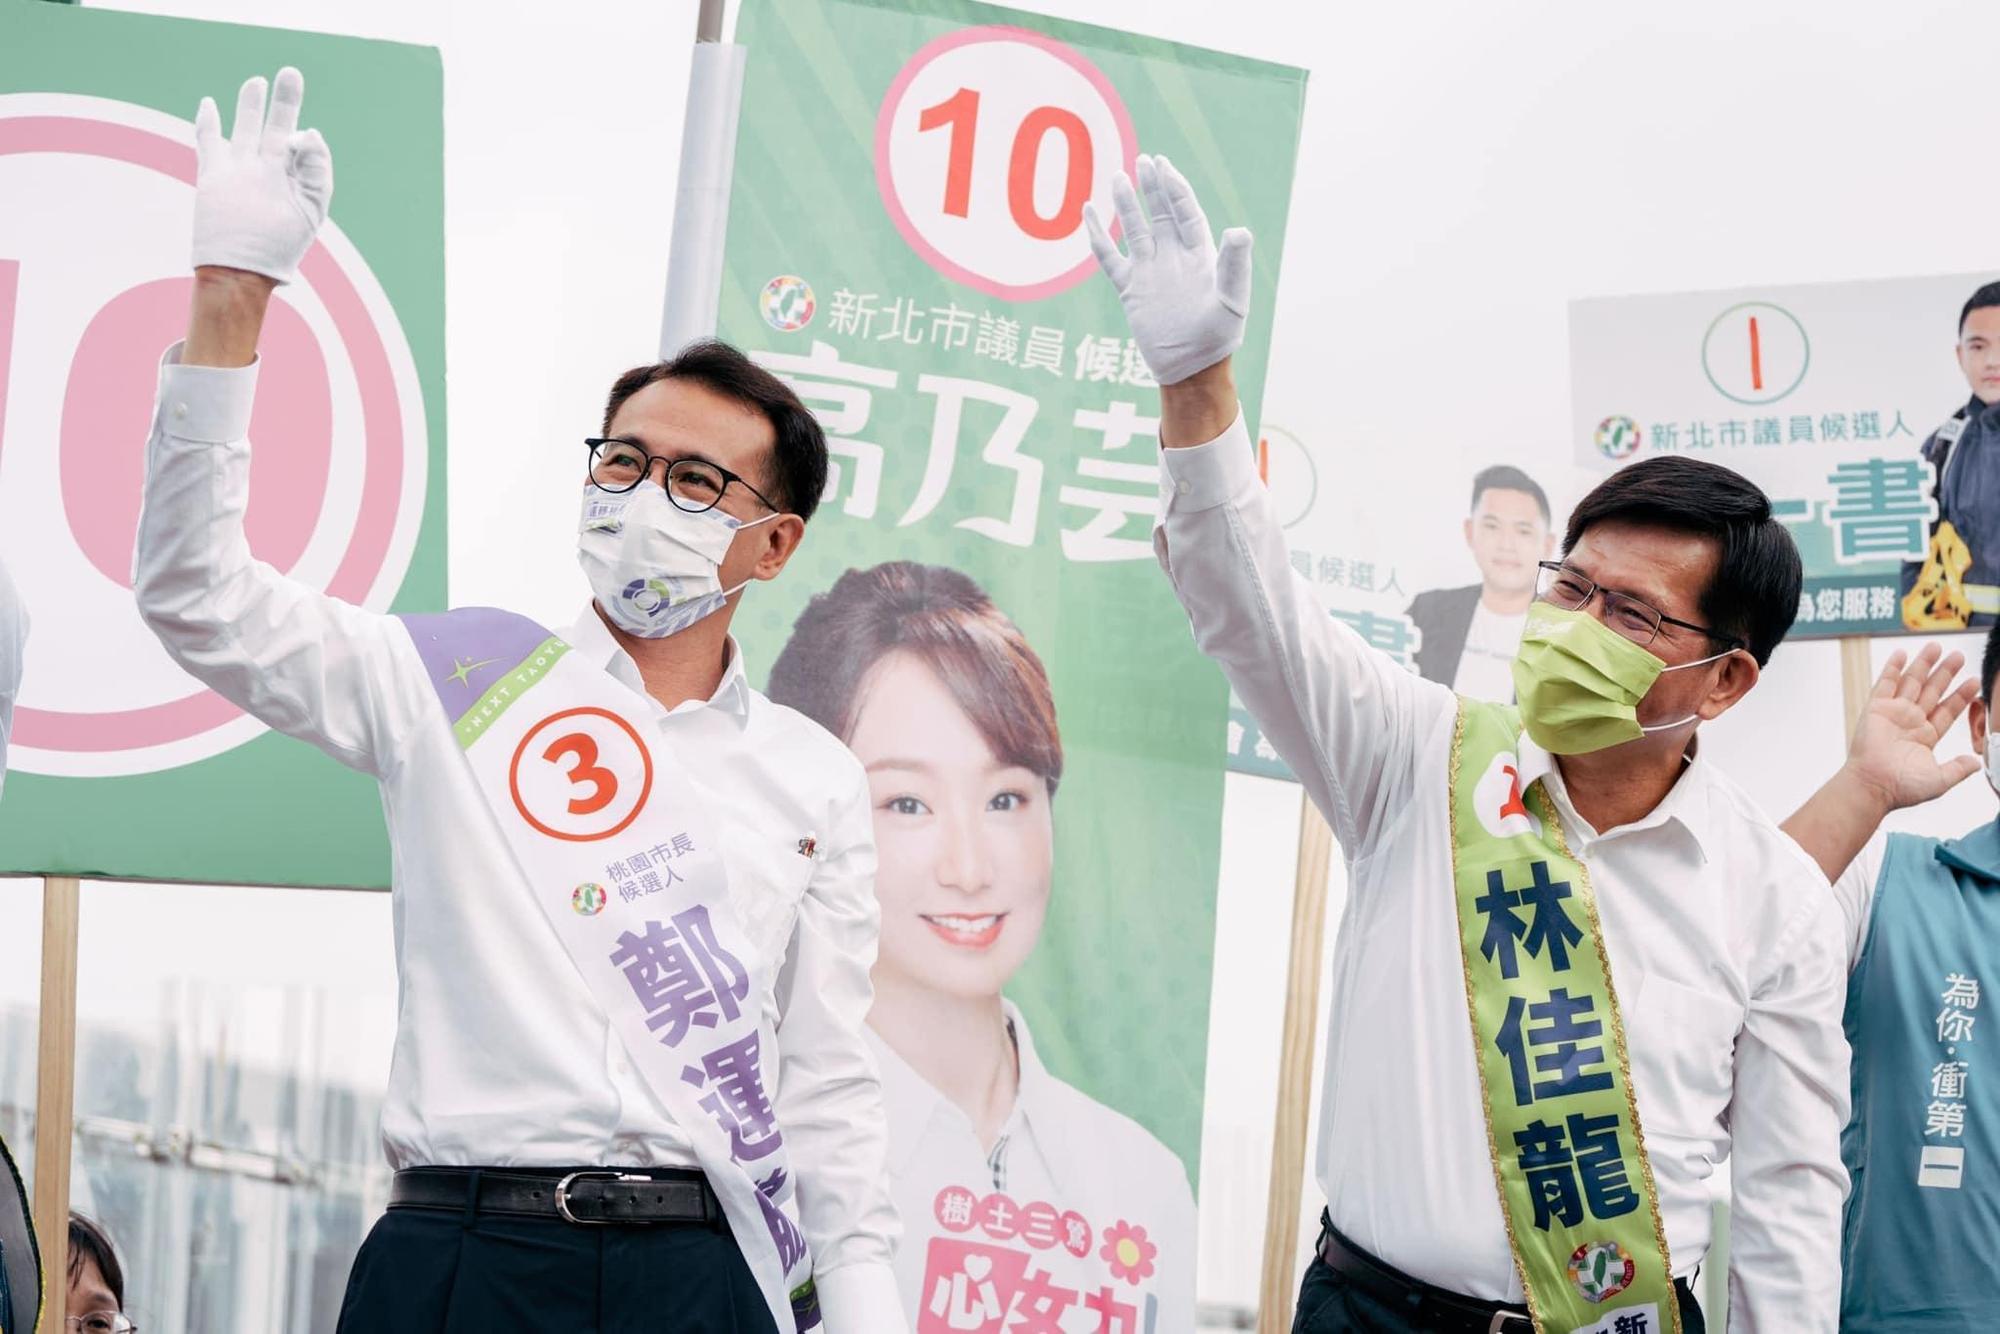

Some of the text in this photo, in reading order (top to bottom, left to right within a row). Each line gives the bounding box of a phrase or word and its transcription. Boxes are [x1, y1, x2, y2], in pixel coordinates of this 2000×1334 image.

[918, 87, 1094, 241] 10
[1749, 316, 1762, 390] 1
[0, 259, 333, 592] 0
[1650, 410, 1914, 452] 新北市議員候選人
[471, 687, 511, 728] NEXT
[542, 732, 618, 815] 3
[605, 832, 696, 883] 桃園市長
[618, 865, 684, 903] 候選人
[1475, 860, 1640, 1232] 林佳龍
